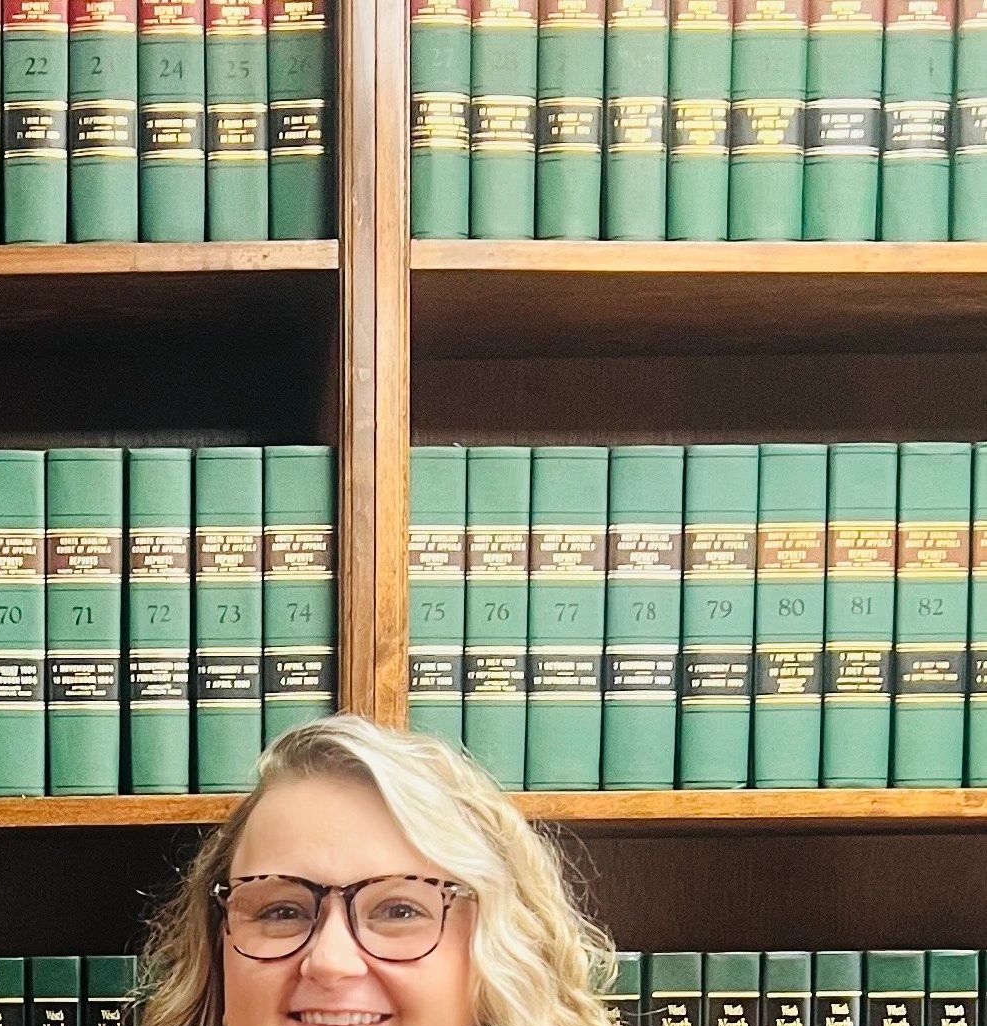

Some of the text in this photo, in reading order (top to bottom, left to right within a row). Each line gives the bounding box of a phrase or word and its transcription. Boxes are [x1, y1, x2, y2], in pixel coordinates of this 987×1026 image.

[24, 56, 48, 77] 22
[159, 59, 183, 80] 24
[228, 60, 250, 79] 25
[147, 604, 170, 625] 72
[217, 604, 241, 624] 73
[286, 602, 313, 623] 74
[421, 601, 446, 622] 75
[484, 602, 510, 622] 76
[554, 602, 580, 622] 77
[632, 601, 656, 622] 78
[707, 600, 733, 620] 79
[778, 598, 805, 617] 80
[851, 596, 872, 615] 81
[918, 598, 944, 616] 82
[72, 606, 93, 626] 71
